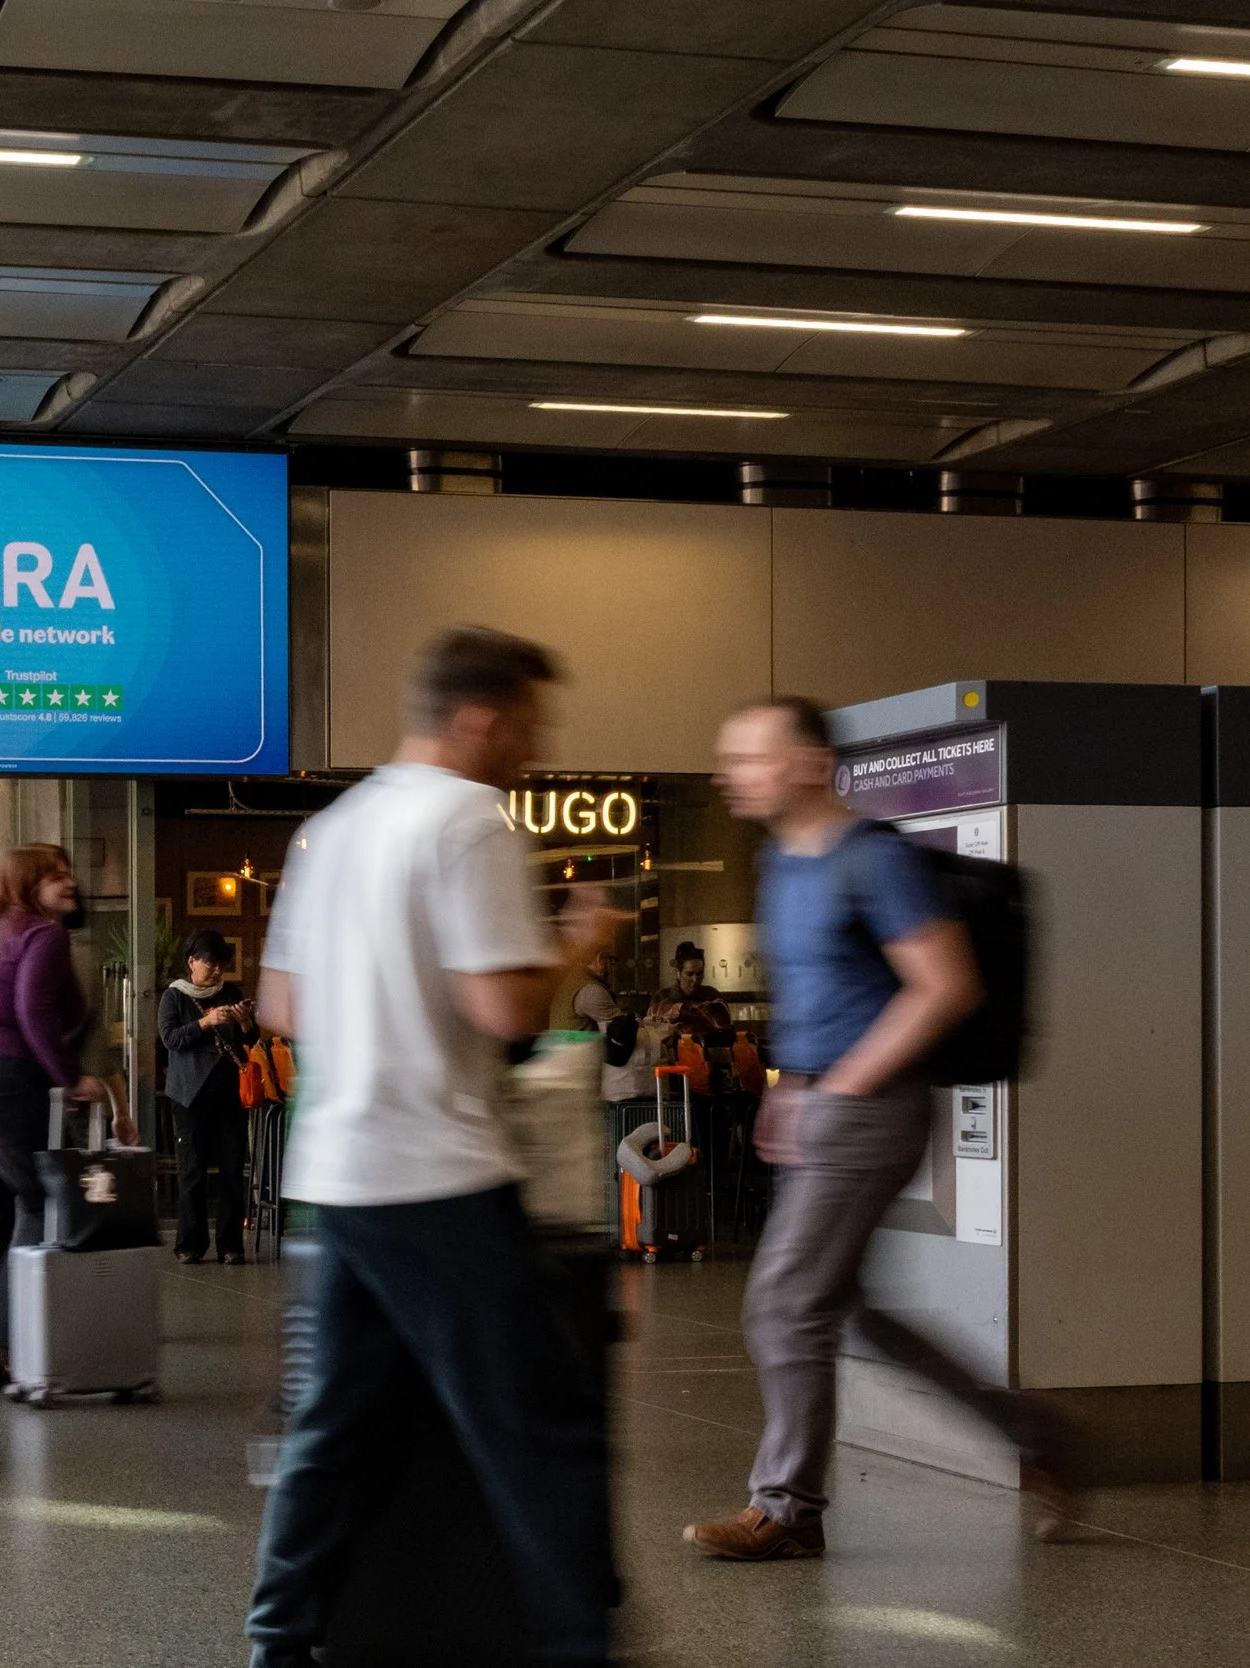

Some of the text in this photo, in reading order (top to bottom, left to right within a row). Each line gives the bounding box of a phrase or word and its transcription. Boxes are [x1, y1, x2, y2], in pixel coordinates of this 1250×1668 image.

[19, 624, 116, 645] network
[5, 669, 58, 682] Trustpilot
[90, 714, 122, 723] reviews
[853, 738, 995, 776] BUY AND COLLECT ALL TICKETS HERE
[853, 763, 955, 792] CASH AND CARD PAYMENTS
[958, 1145, 989, 1154] Banknotes Out
